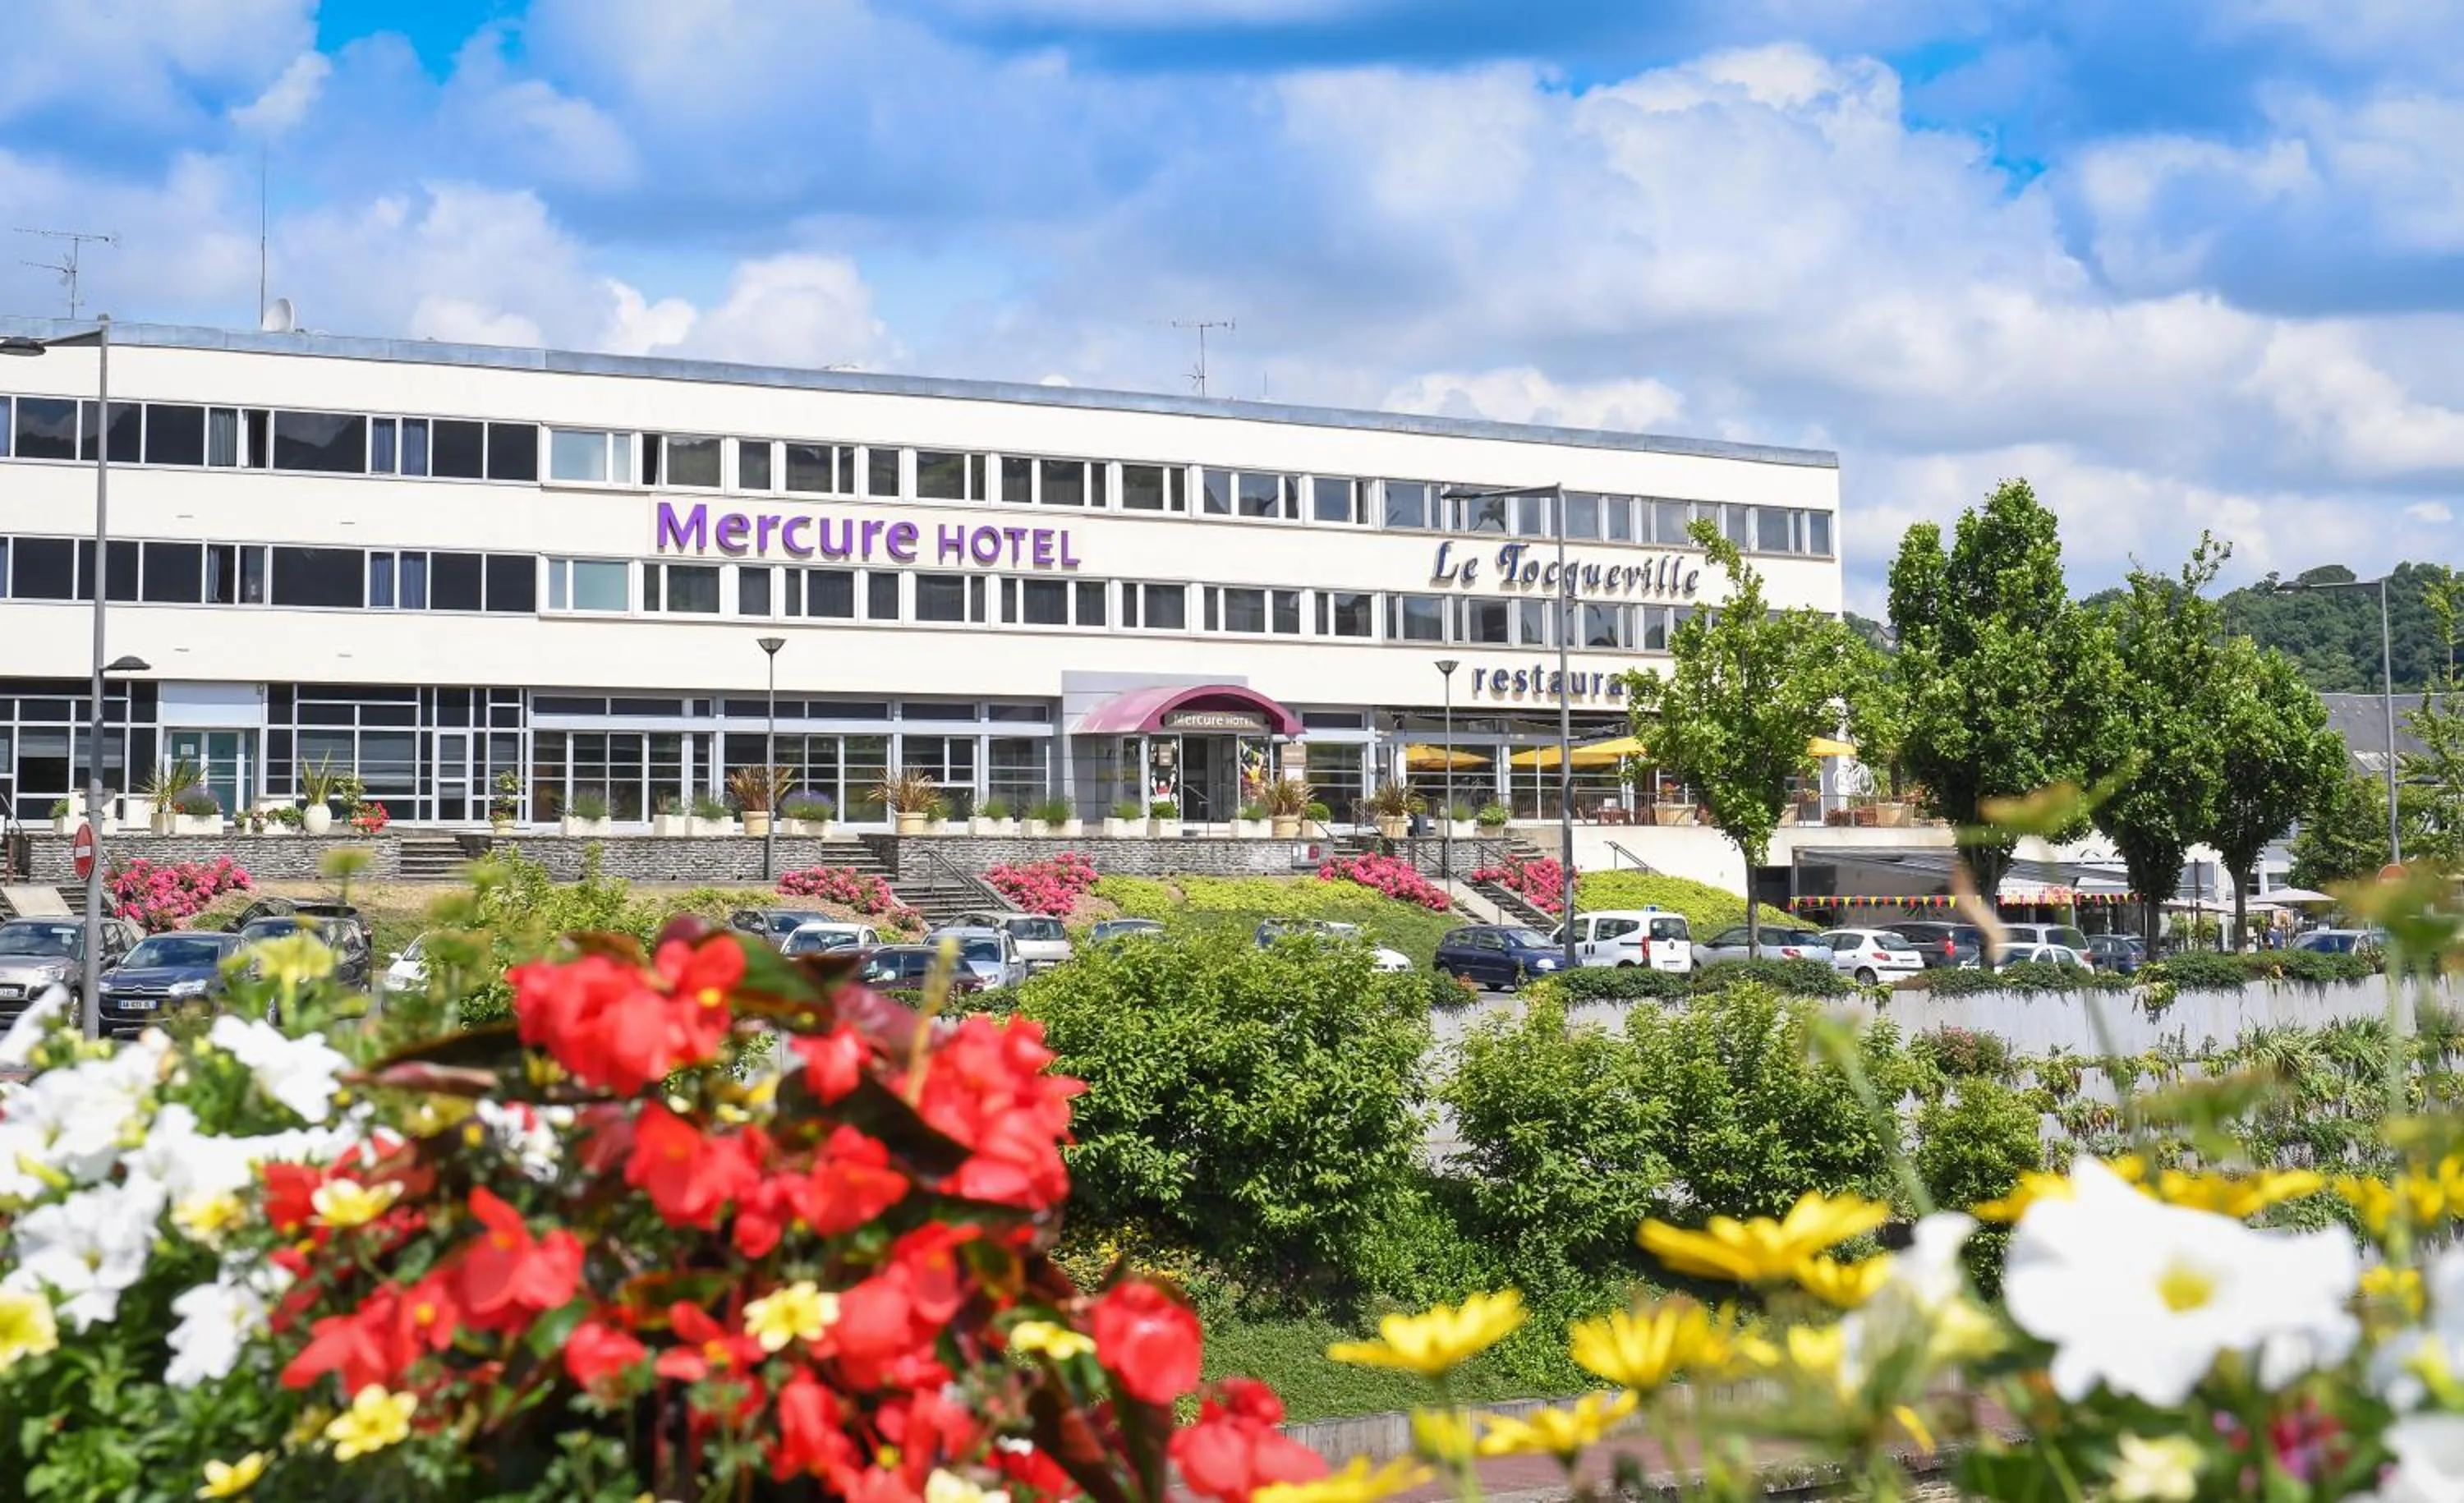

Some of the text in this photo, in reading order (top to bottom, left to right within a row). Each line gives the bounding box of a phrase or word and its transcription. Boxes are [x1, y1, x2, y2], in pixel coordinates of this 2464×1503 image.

[657, 502, 1080, 568] Mercure HOTEL
[1434, 540, 1699, 598] Le Tocqueville
[1473, 662, 1651, 696] restaura
[1174, 714, 1223, 726] Mercure
